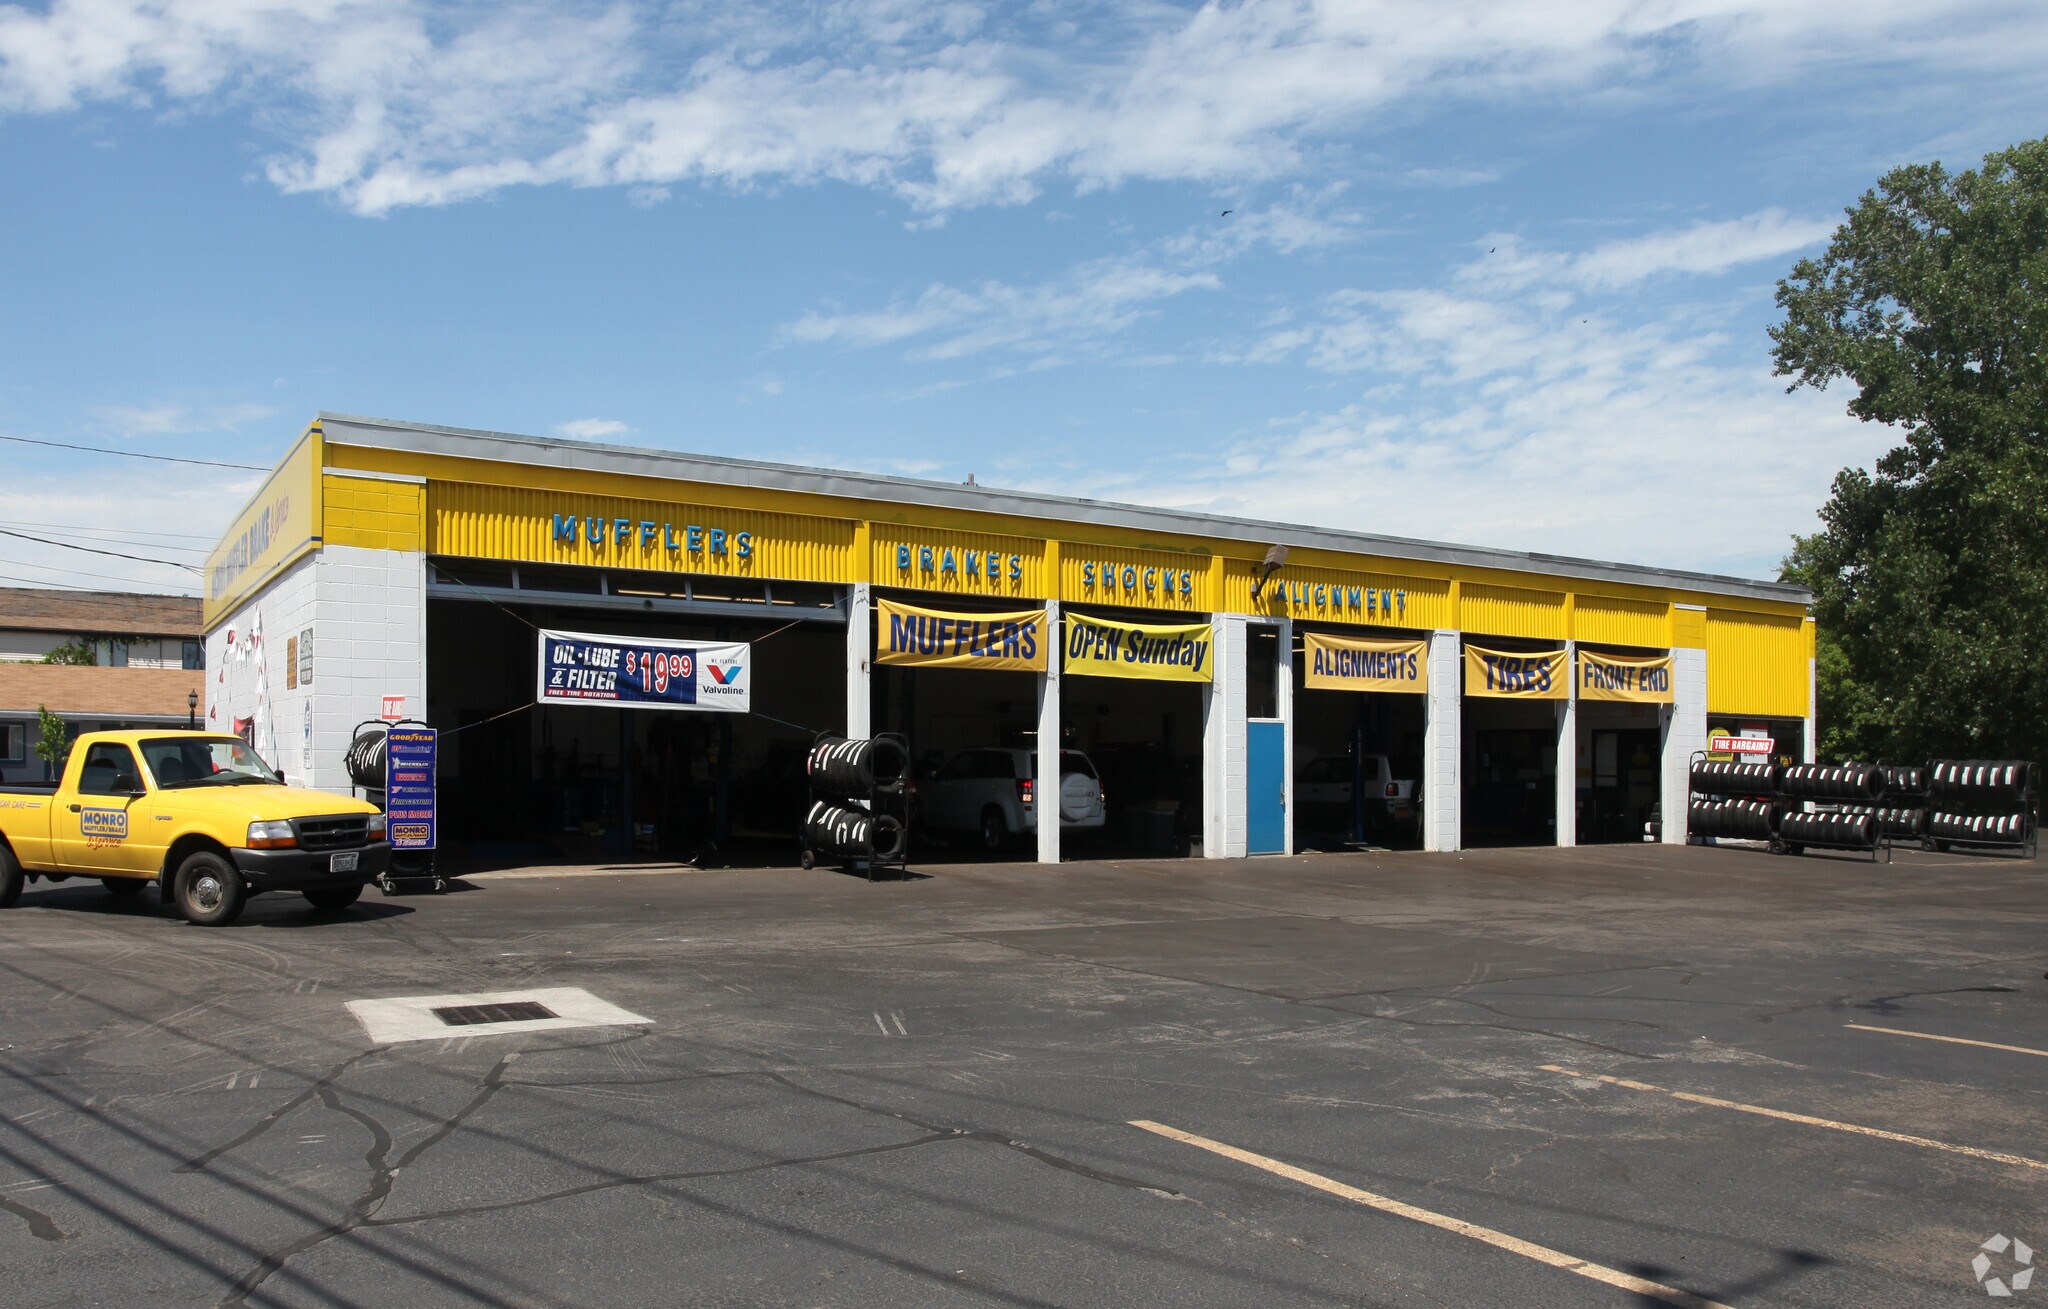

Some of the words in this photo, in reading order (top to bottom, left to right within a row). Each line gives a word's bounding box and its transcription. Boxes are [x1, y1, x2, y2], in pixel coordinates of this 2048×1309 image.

[249, 505, 270, 566] BRAKE
[553, 513, 754, 558] MUFFLERS
[897, 545, 1022, 580] BRAKES
[1082, 562, 1192, 594] SHOCKS
[1276, 580, 1406, 611] ALIGNMENT
[890, 613, 1037, 660] MUFFLERS
[1068, 622, 1124, 661] OPEN
[1123, 628, 1208, 672] Sunday
[553, 644, 575, 665] OIL
[583, 646, 620, 668] LUBE
[1313, 647, 1417, 681] ALIGNMENTS
[551, 670, 563, 685] &
[566, 668, 617, 691] FILTER
[1482, 654, 1552, 692] TIRES
[1583, 662, 1636, 691] FRONT
[1638, 666, 1669, 692] END
[702, 685, 744, 695] Valvoline
[389, 733, 434, 742] GOODYEAR
[1714, 739, 1730, 750] TIRE
[1731, 740, 1770, 752] BARGAINS
[83, 812, 125, 826] MONRO
[84, 825, 125, 833] MUFFLER/BRAKE
[389, 810, 408, 818] PLUS
[408, 810, 433, 818] MORE!
